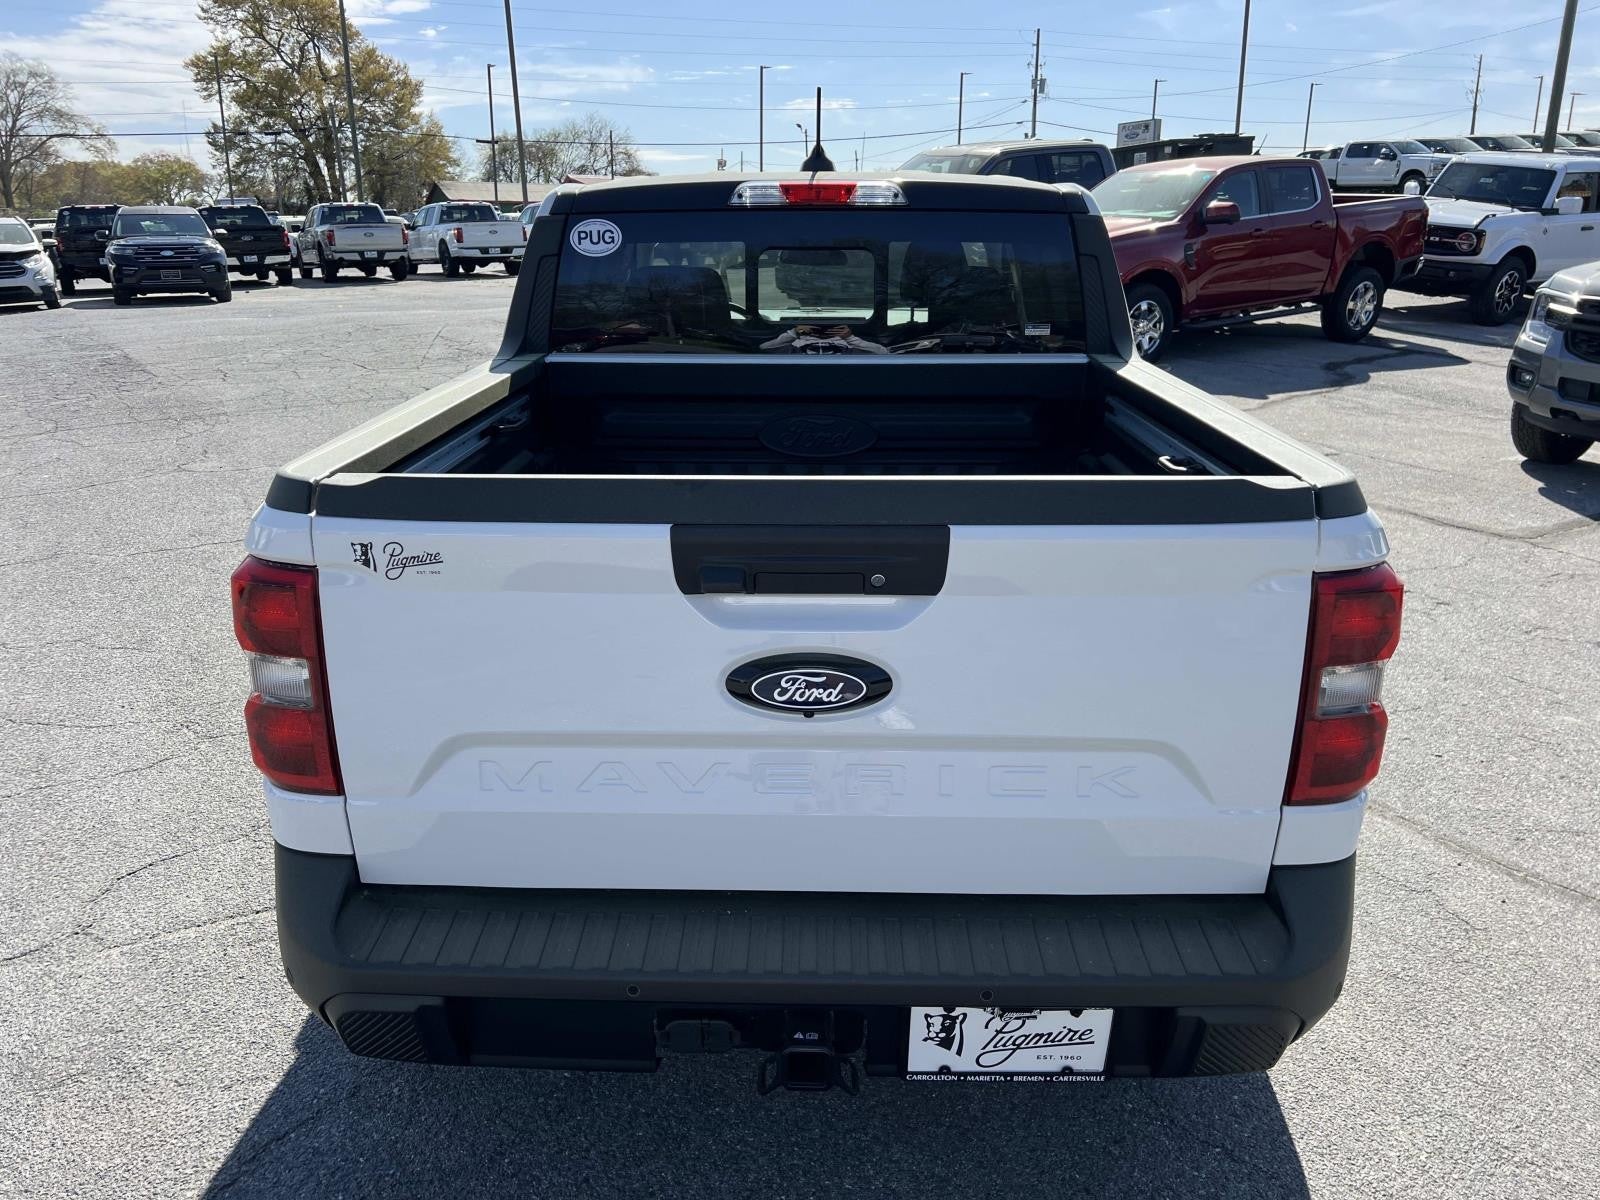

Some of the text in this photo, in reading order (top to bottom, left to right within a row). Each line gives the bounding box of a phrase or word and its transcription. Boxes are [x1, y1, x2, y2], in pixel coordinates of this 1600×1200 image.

[577, 229, 615, 246] PUG
[382, 541, 444, 581] Pugmire
[773, 674, 845, 702] Ford
[478, 759, 1141, 799] MAVERICK
[975, 1015, 1095, 1068] Pugmire
[906, 1074, 958, 1082] CARROLLTON
